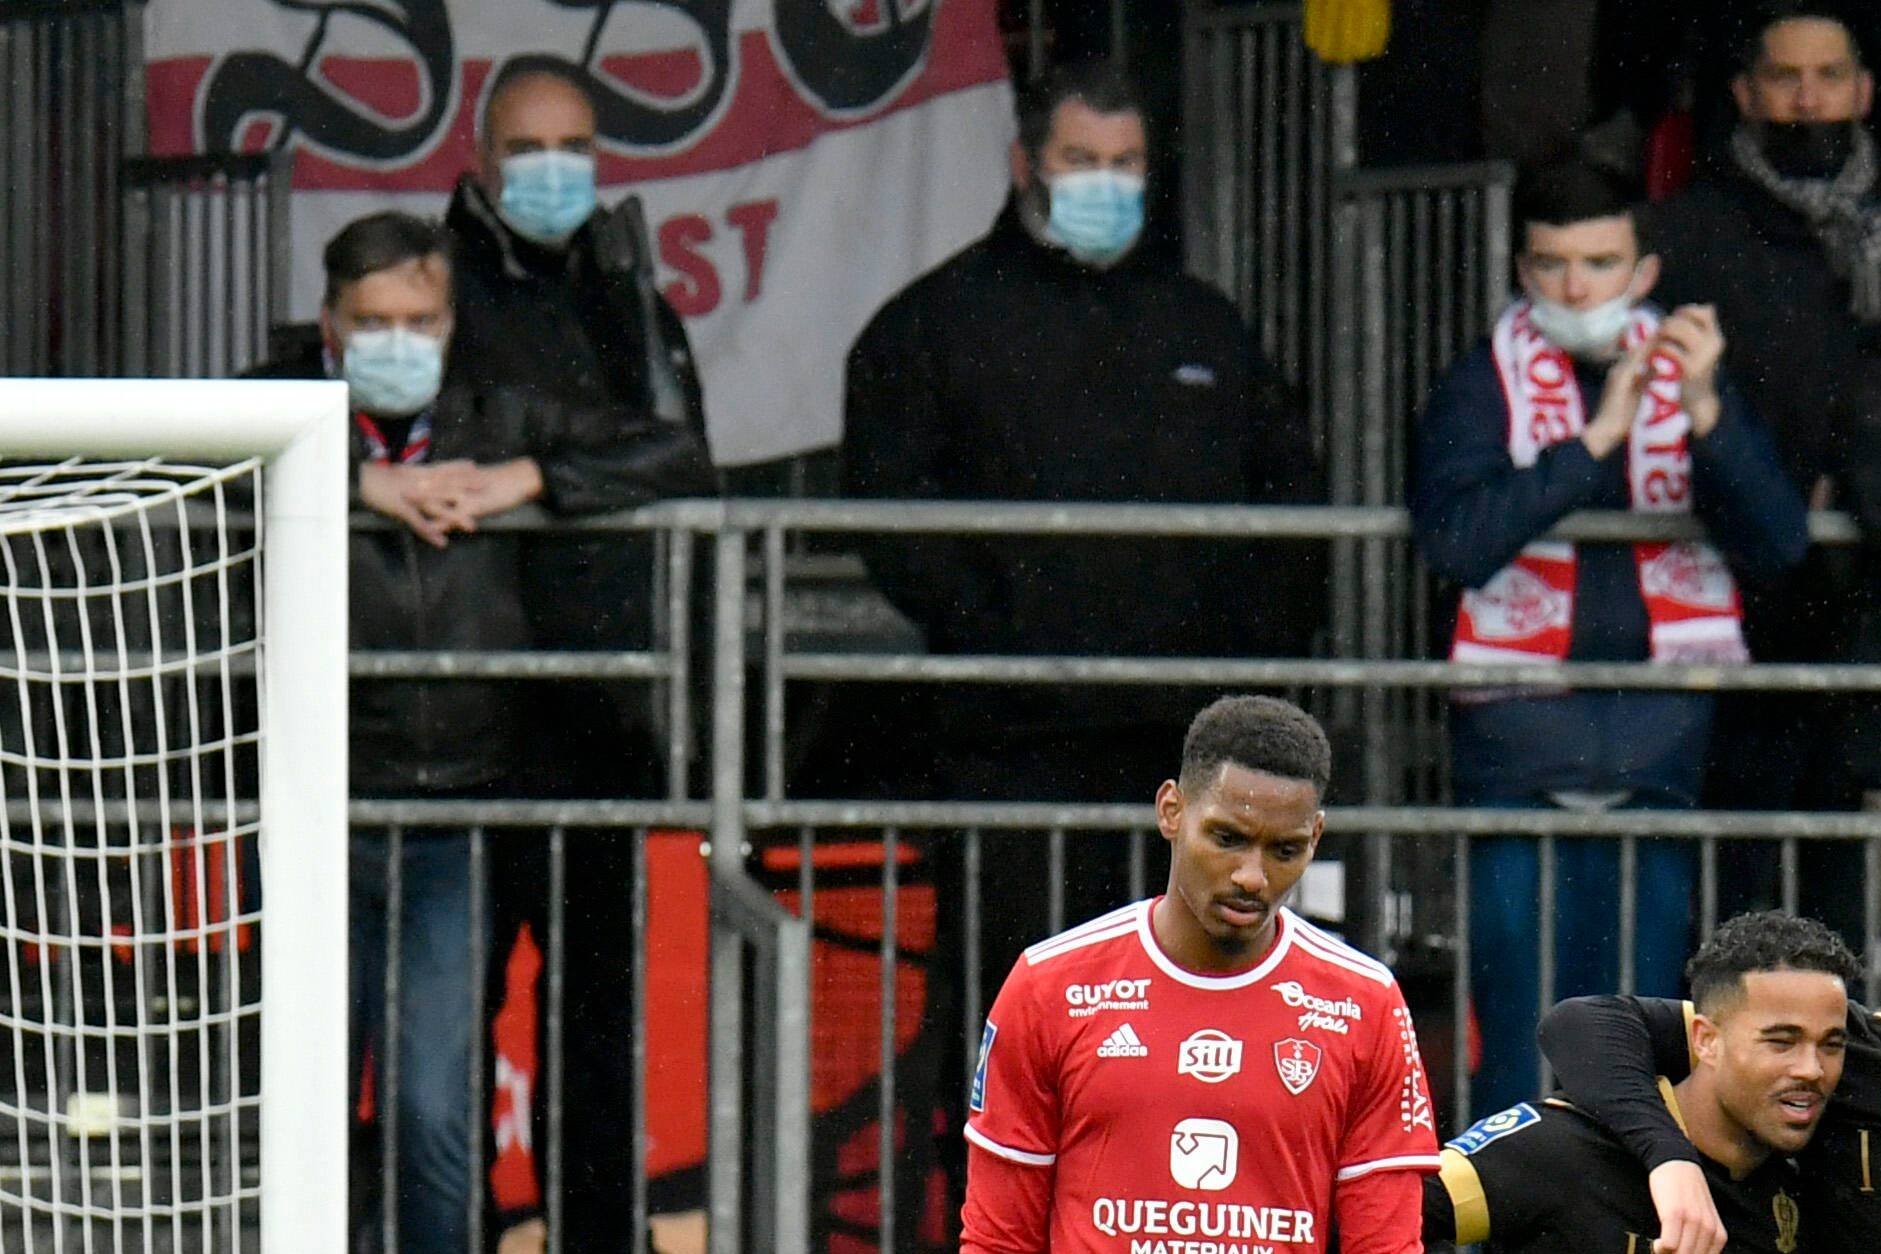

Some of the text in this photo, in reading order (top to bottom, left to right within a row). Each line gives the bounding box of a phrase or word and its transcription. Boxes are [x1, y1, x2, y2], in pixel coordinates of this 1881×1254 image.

[1065, 979, 1151, 1006] GUYOT
[1271, 981, 1362, 1020] Oceania
[1068, 999, 1149, 1018] envirnnement
[1097, 1044, 1148, 1057] adidas
[1186, 1045, 1233, 1067] Sill
[1093, 1197, 1314, 1243] QUEGUINER
